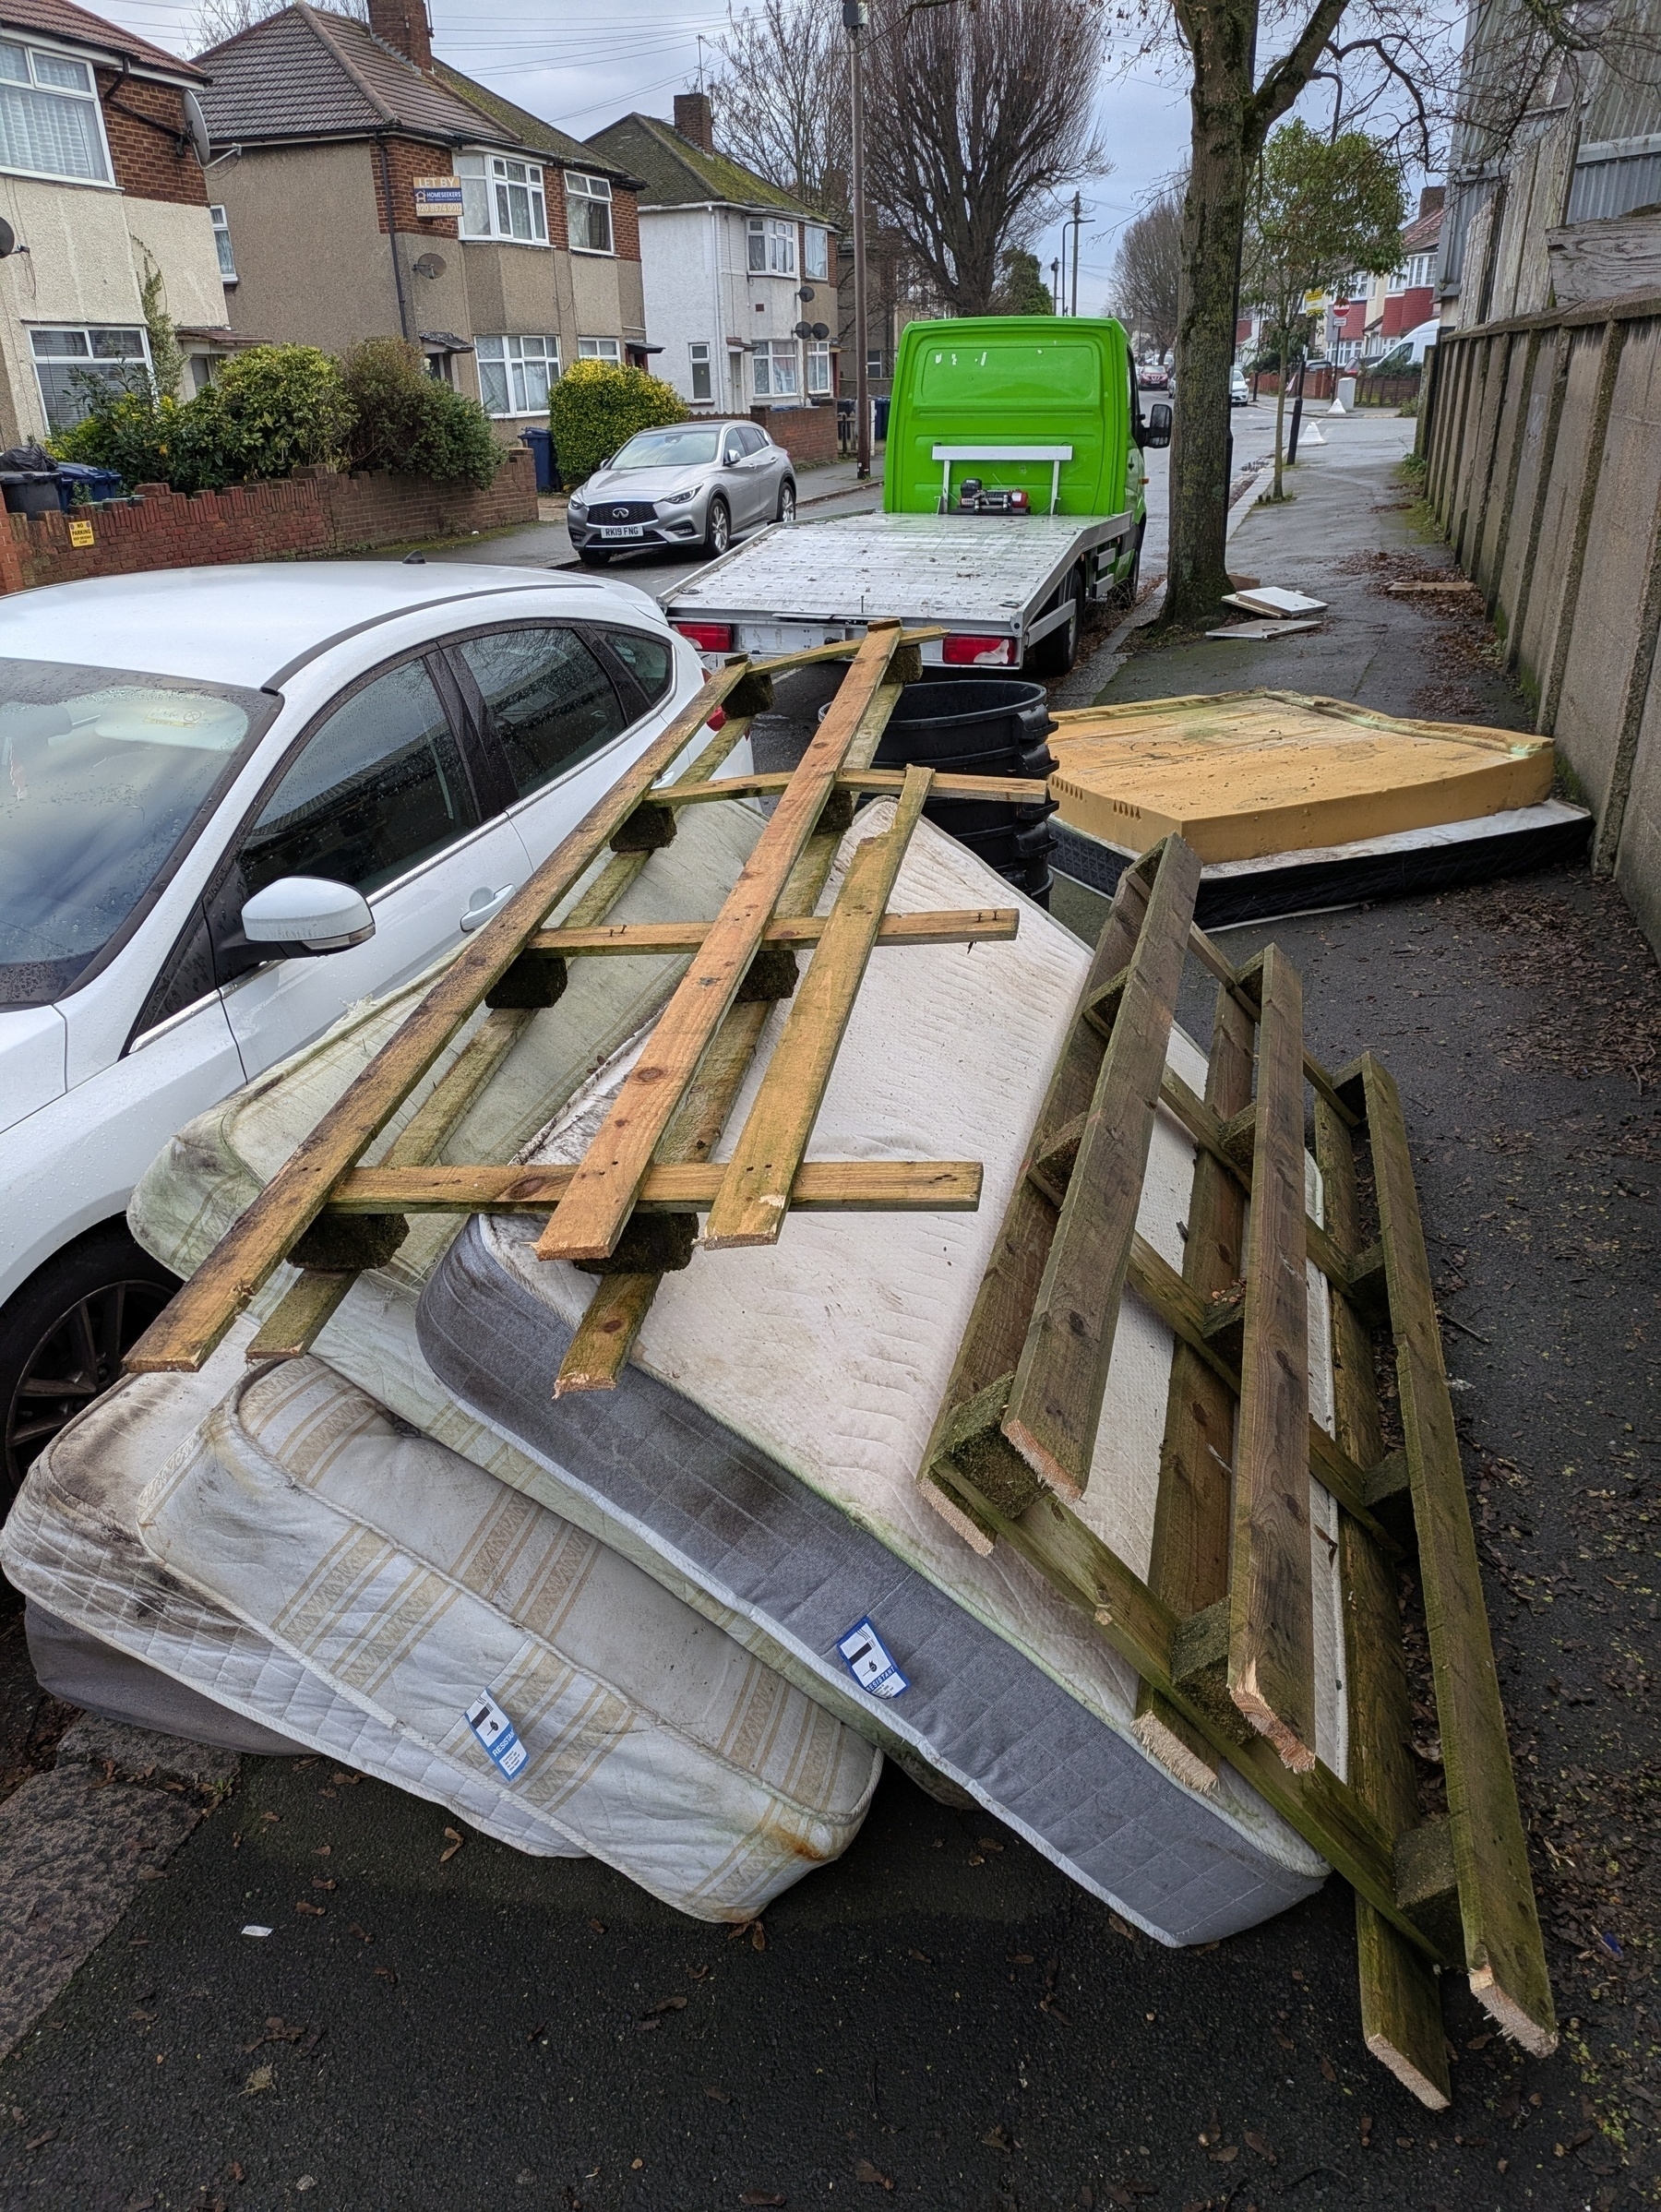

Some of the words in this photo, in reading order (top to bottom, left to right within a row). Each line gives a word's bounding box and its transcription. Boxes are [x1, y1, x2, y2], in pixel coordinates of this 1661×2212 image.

[418, 177, 436, 187] LET
[440, 177, 455, 187] BY
[416, 204, 429, 212] 020
[430, 204, 447, 212] 8574
[605, 527, 622, 536] RK19
[623, 526, 639, 535] FNG
[492, 1728, 515, 1757] RESISTAN
